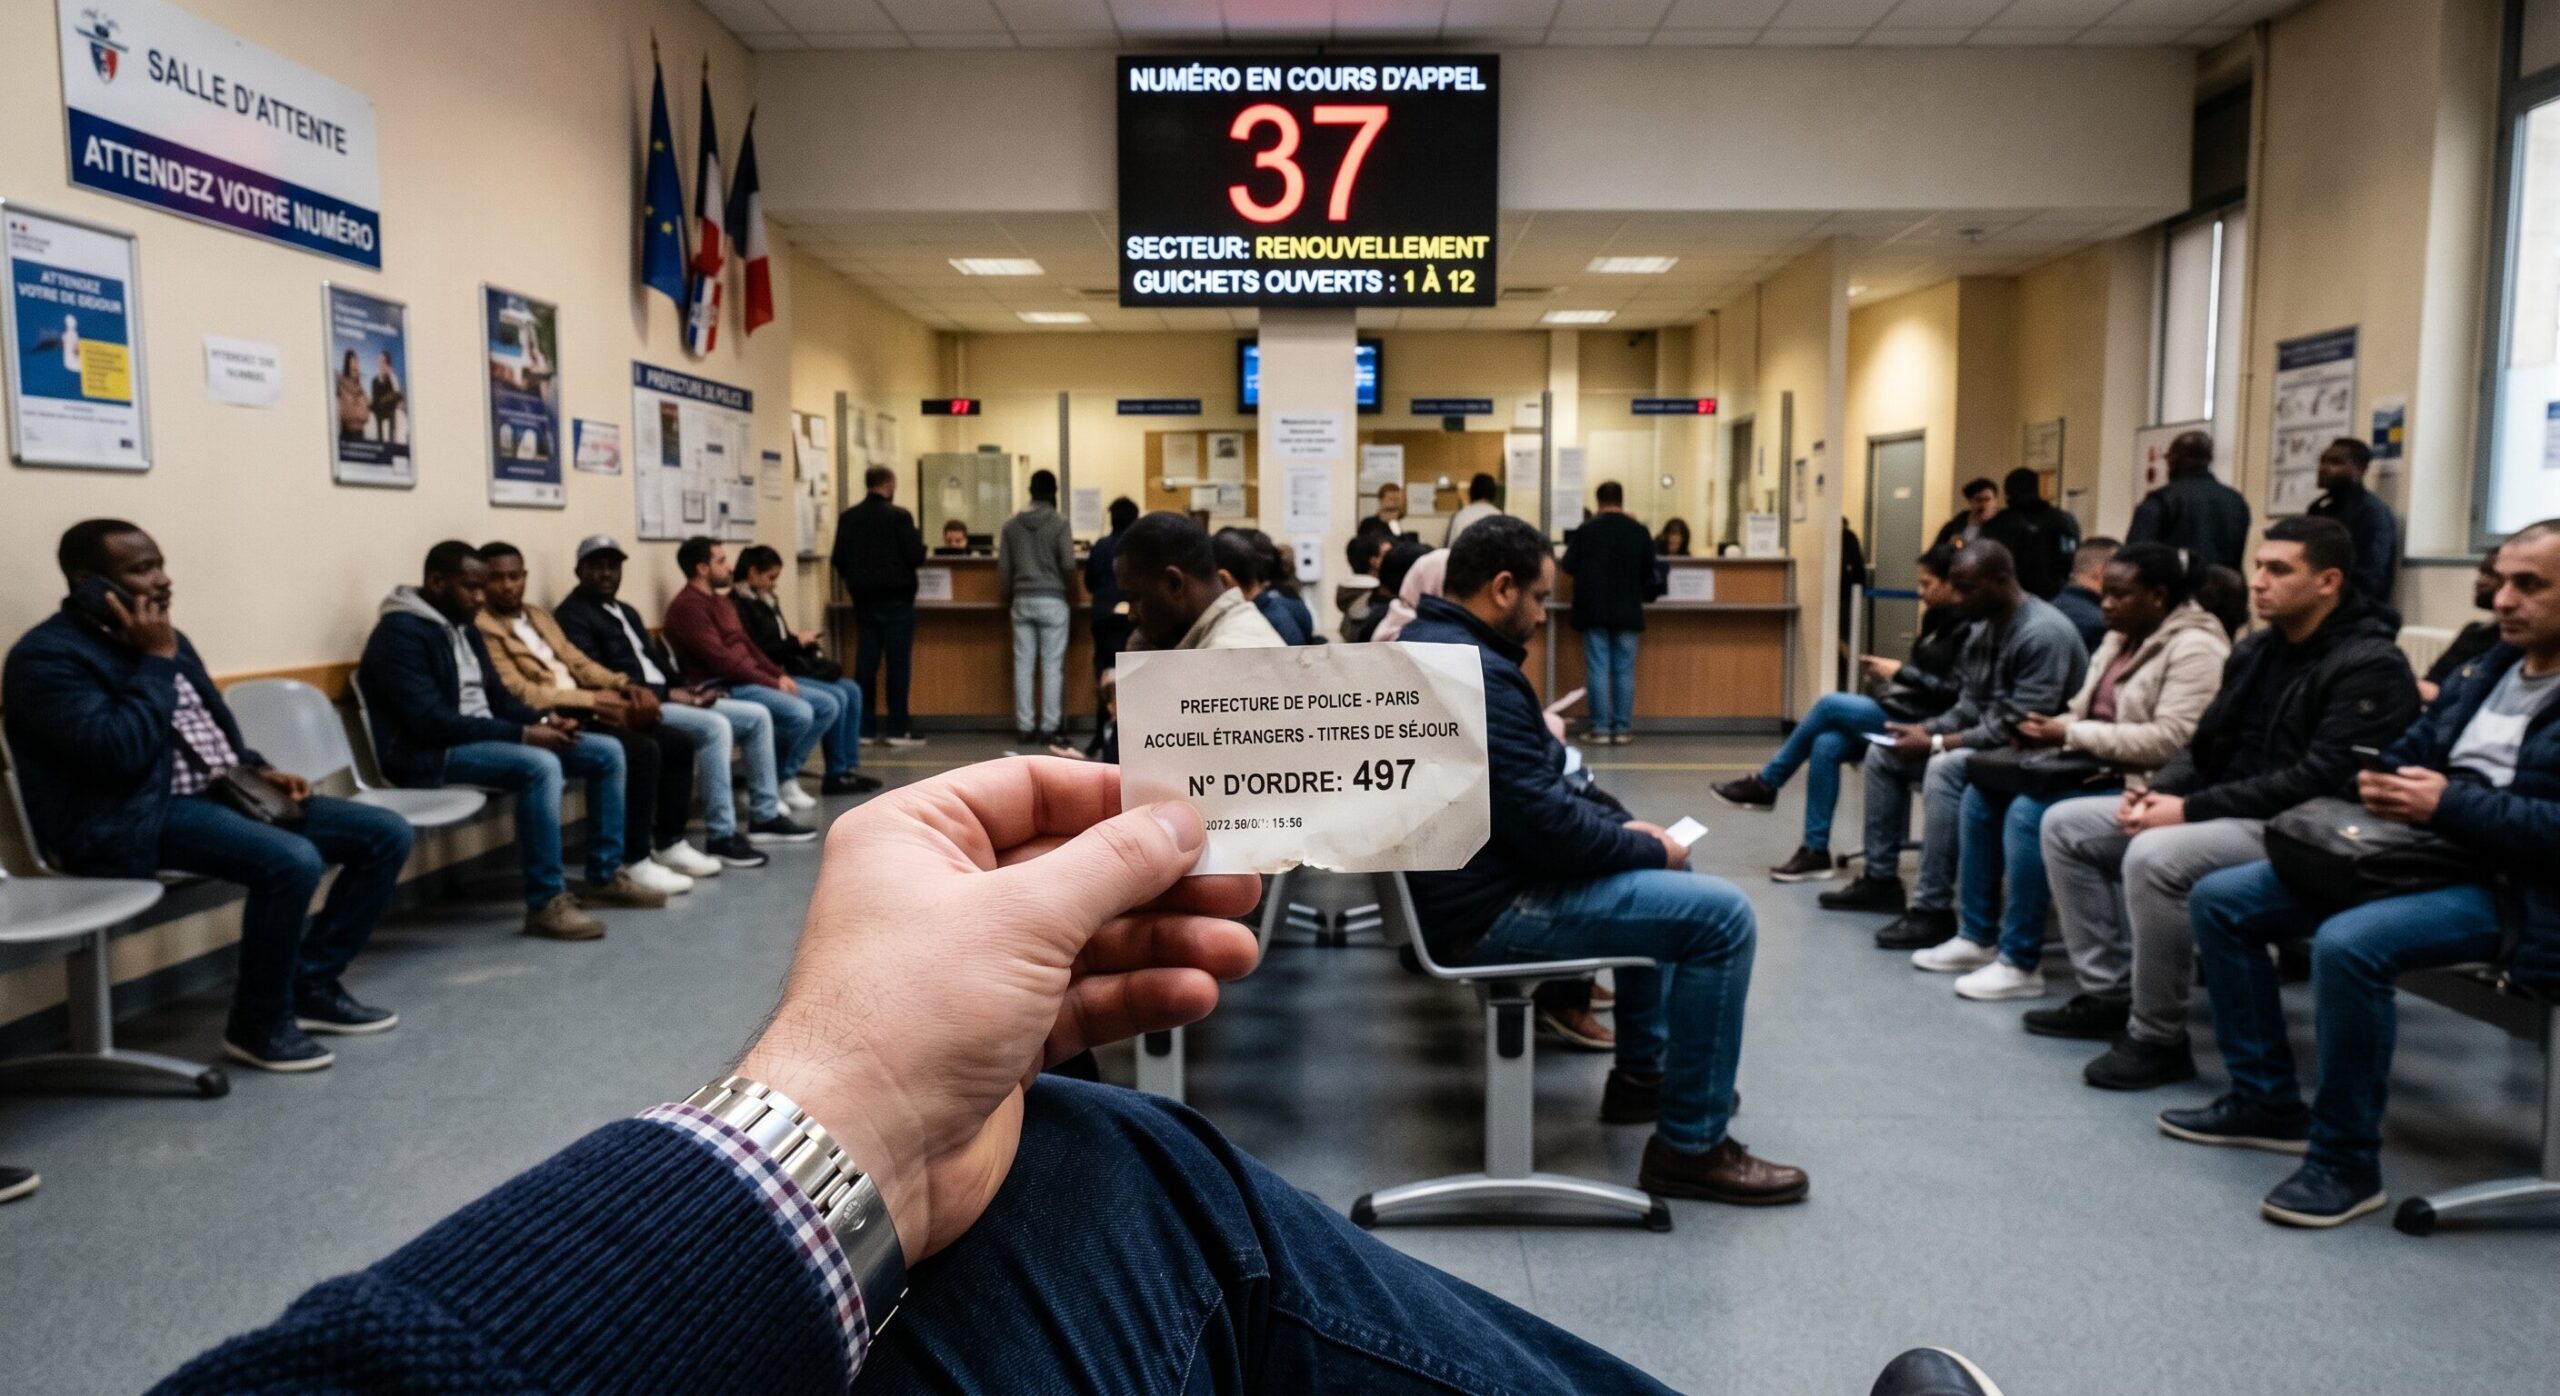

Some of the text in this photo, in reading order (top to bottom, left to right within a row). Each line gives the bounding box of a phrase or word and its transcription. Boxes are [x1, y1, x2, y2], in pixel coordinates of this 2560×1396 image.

[1130, 62, 1487, 92] NUMÉRO EN COURS D'APPEL
[147, 48, 347, 155] SALLE D'ATTENTE
[1228, 103, 1389, 223] 37
[83, 134, 374, 252] ATTENDEZ VOTRE NUMÉRO
[1126, 235, 1490, 260] SECTEUR: RENOUVELLEMENT
[1133, 269, 1260, 294] GUICHETS
[1264, 269, 1383, 294] OUVERTS
[1403, 269, 1415, 294] 1
[1421, 263, 1442, 294] À
[1447, 269, 1476, 294] 12
[1180, 697, 1280, 714] PREFECTURE
[1284, 695, 1304, 710] DE
[1308, 693, 1362, 709] POLICE
[1375, 690, 1420, 706] PARIS
[1144, 731, 1210, 749] ACCUEIL
[1213, 727, 1304, 747] ÉTRANGERS
[1317, 725, 1370, 742] TITRES
[1374, 723, 1395, 740] DE
[1399, 719, 1459, 739] SÉJOUR
[1189, 758, 1417, 797] N° D'ORDRE: 497
[1273, 817, 1303, 829] 15:56
